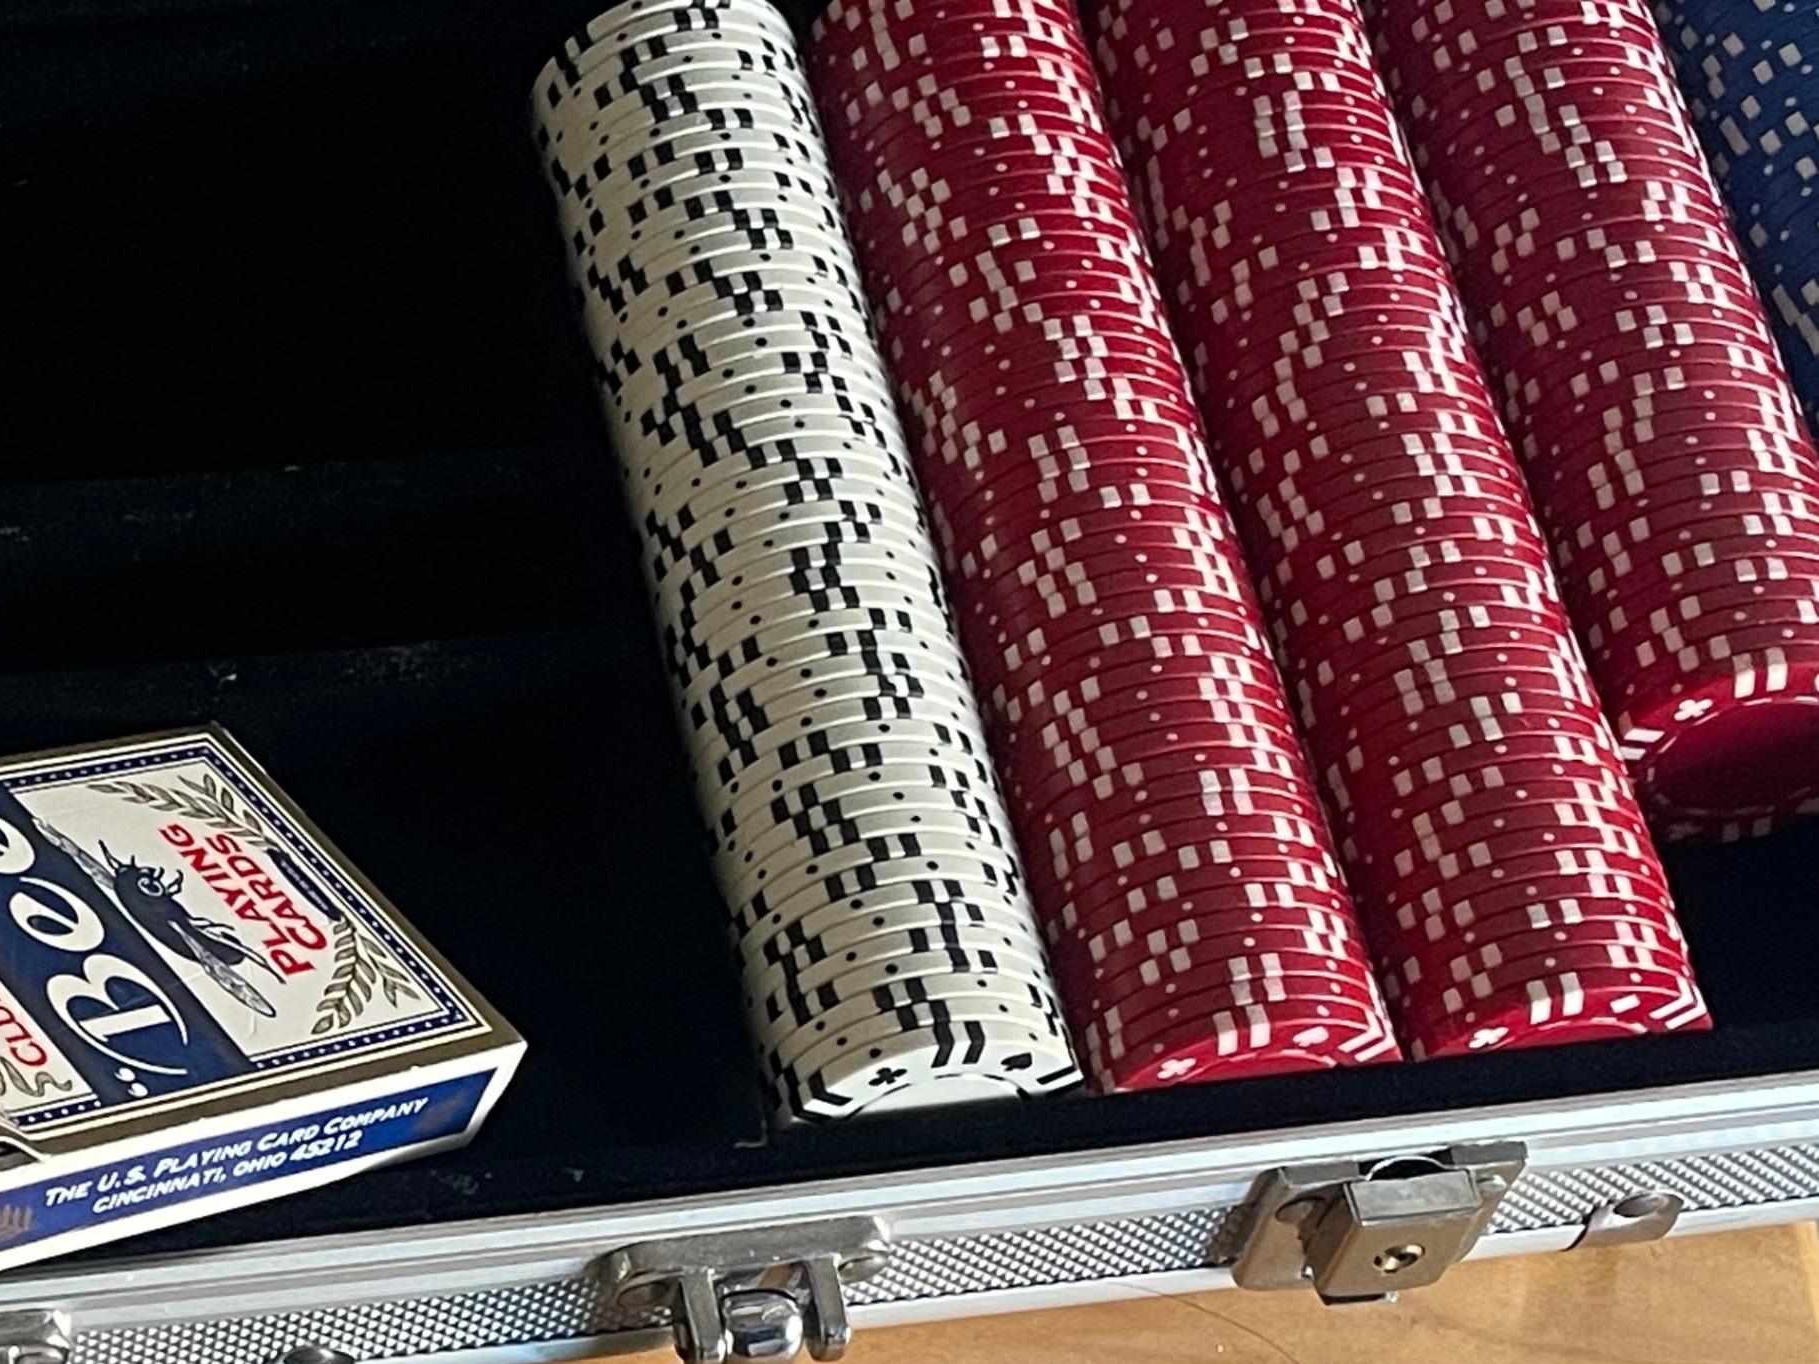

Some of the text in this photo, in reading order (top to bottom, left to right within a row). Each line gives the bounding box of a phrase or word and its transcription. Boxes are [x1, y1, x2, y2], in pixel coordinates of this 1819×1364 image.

[158, 823, 317, 977] PLAYING
[204, 833, 328, 951] CARDS
[45, 1180, 94, 1207] THE
[153, 1139, 254, 1179] PLAYING
[257, 1123, 321, 1152] CARD
[323, 1096, 430, 1135] COMPANY
[232, 1151, 288, 1178] OHIO
[289, 1129, 364, 1161] 45212
